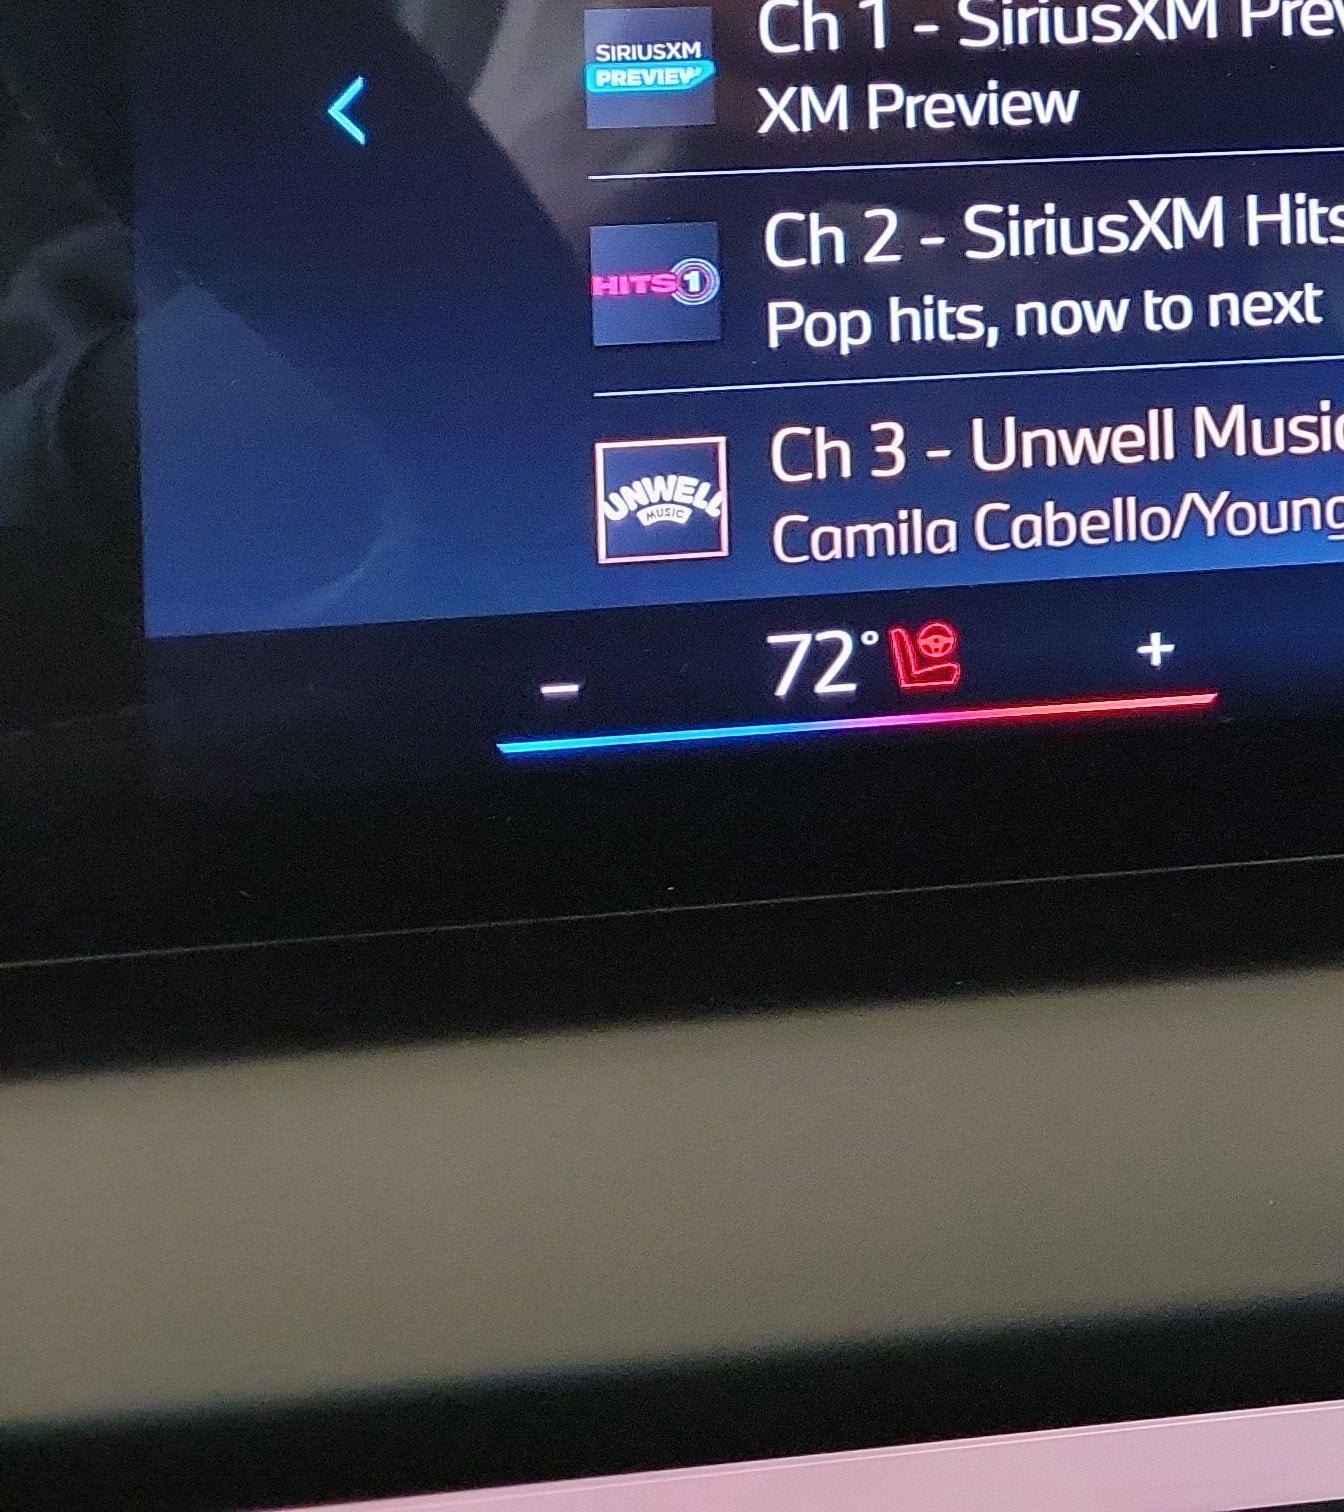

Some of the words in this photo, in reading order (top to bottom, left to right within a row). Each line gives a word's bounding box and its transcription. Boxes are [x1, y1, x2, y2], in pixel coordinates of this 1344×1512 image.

[595, 41, 702, 62] SIRIUSXM
[595, 67, 703, 88] PREVIEW
[756, 84, 849, 134] XM
[867, 79, 1081, 130] Preview
[764, 211, 846, 268] Ch
[863, 208, 902, 263] 2
[964, 195, 1225, 261] SiriusXM
[590, 273, 678, 296] HITS
[767, 300, 873, 356] Pop
[889, 294, 1000, 348] hits,
[1015, 298, 1131, 337] now
[1143, 289, 1194, 332] to
[1208, 282, 1324, 328] next
[771, 426, 852, 483] Ch
[870, 421, 906, 477] 3
[972, 407, 1175, 472] Unwell
[603, 474, 722, 521] UNWELL
[773, 508, 957, 563] Camila
